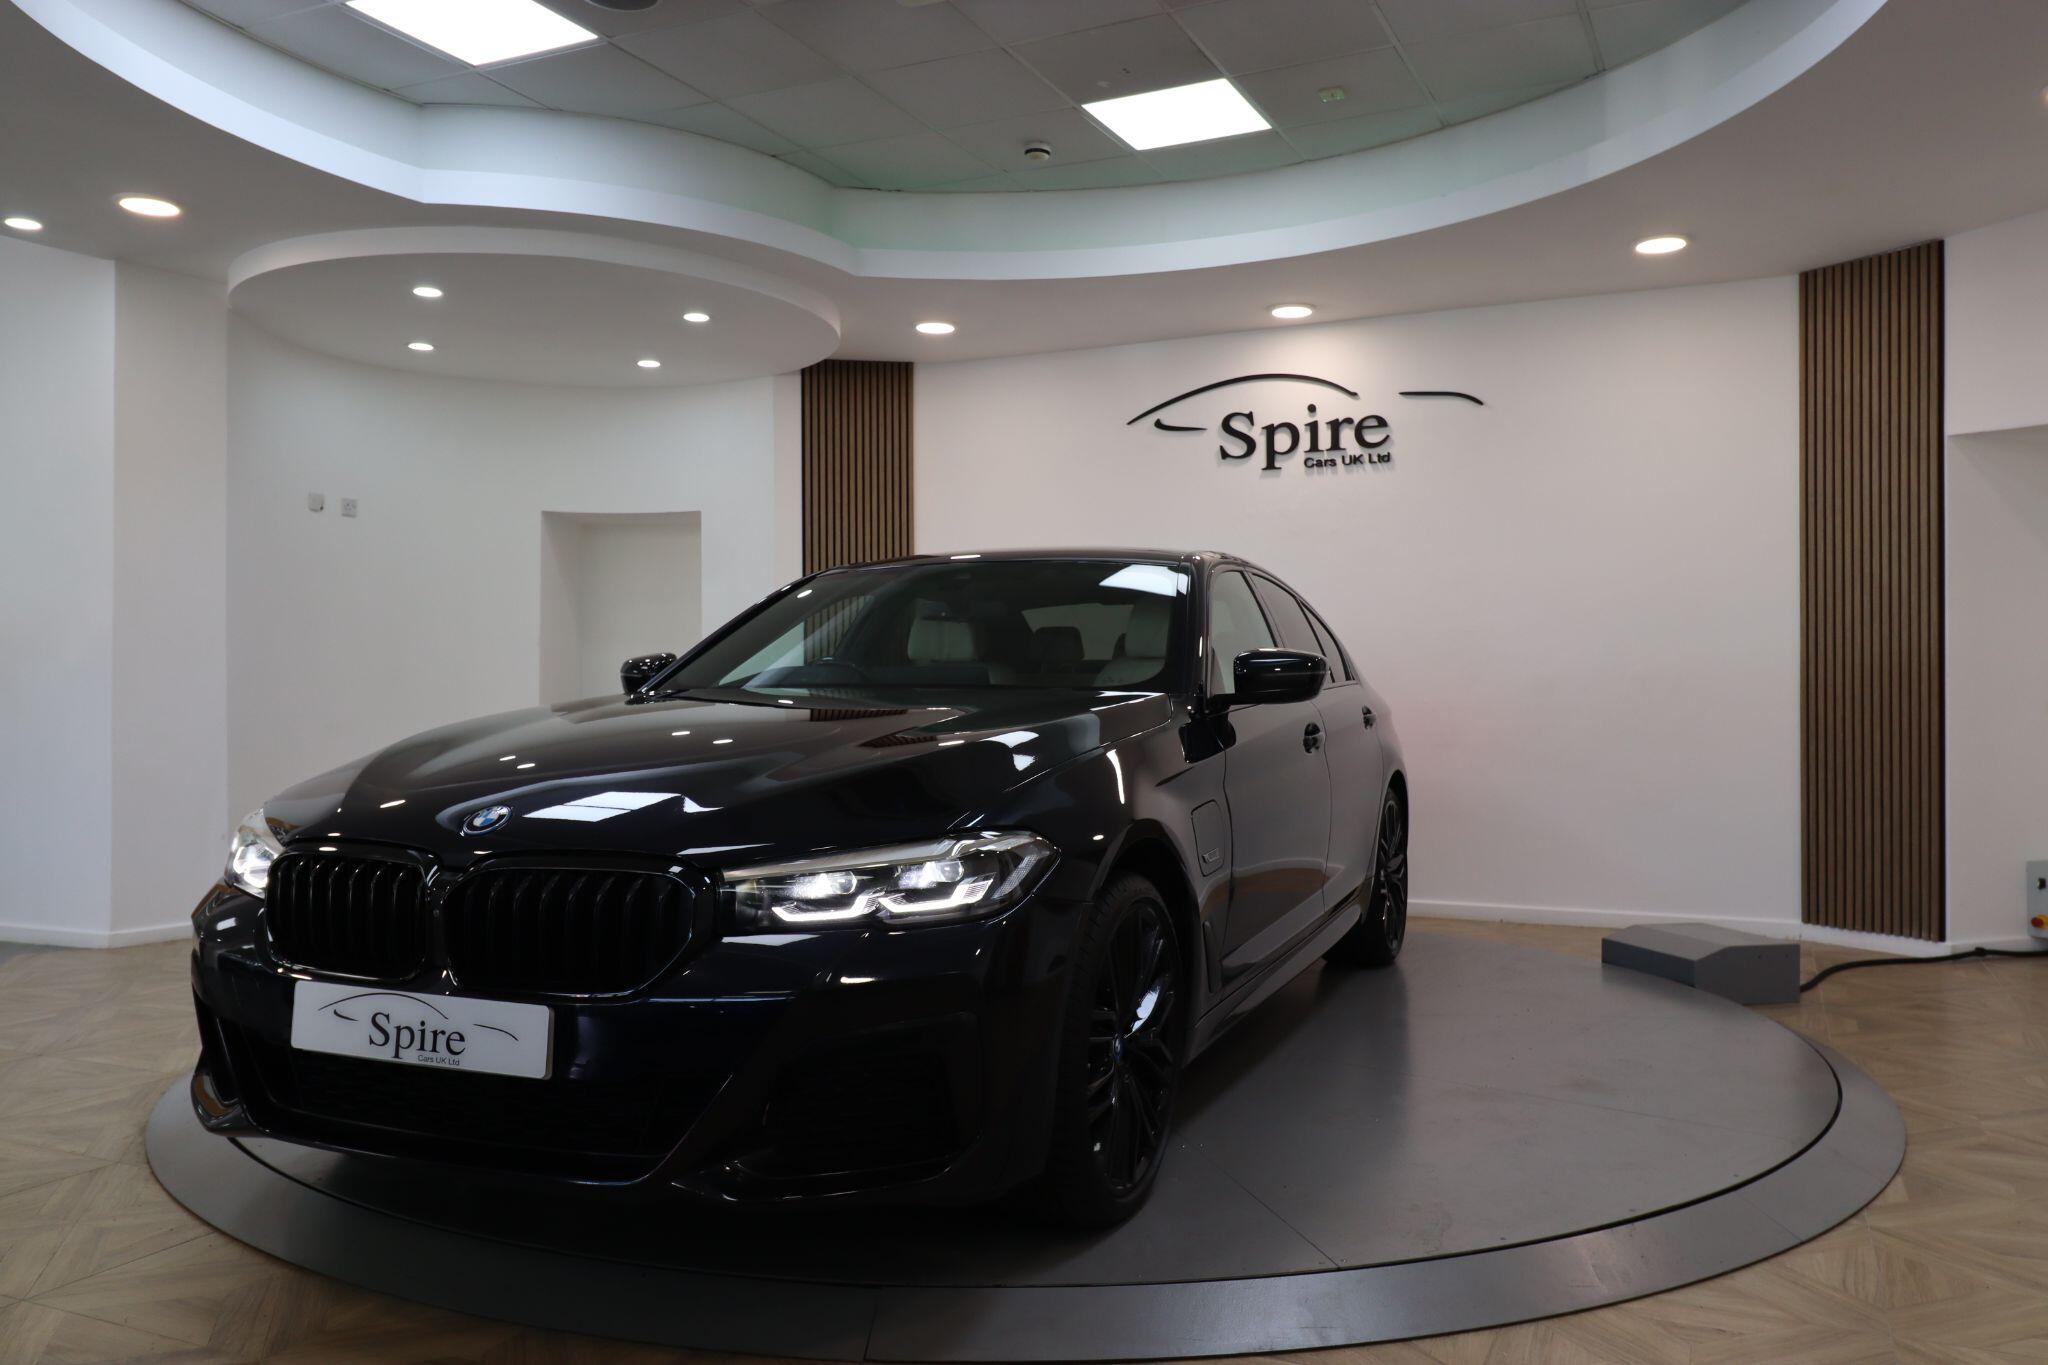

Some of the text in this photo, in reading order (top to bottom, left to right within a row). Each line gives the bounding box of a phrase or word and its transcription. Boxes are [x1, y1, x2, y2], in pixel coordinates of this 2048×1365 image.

[1219, 404, 1390, 470] Spire
[1304, 452, 1391, 468] Cars UK Ltd
[368, 1012, 466, 1059] Spire
[417, 1055, 460, 1066] Cars UK Ltd
